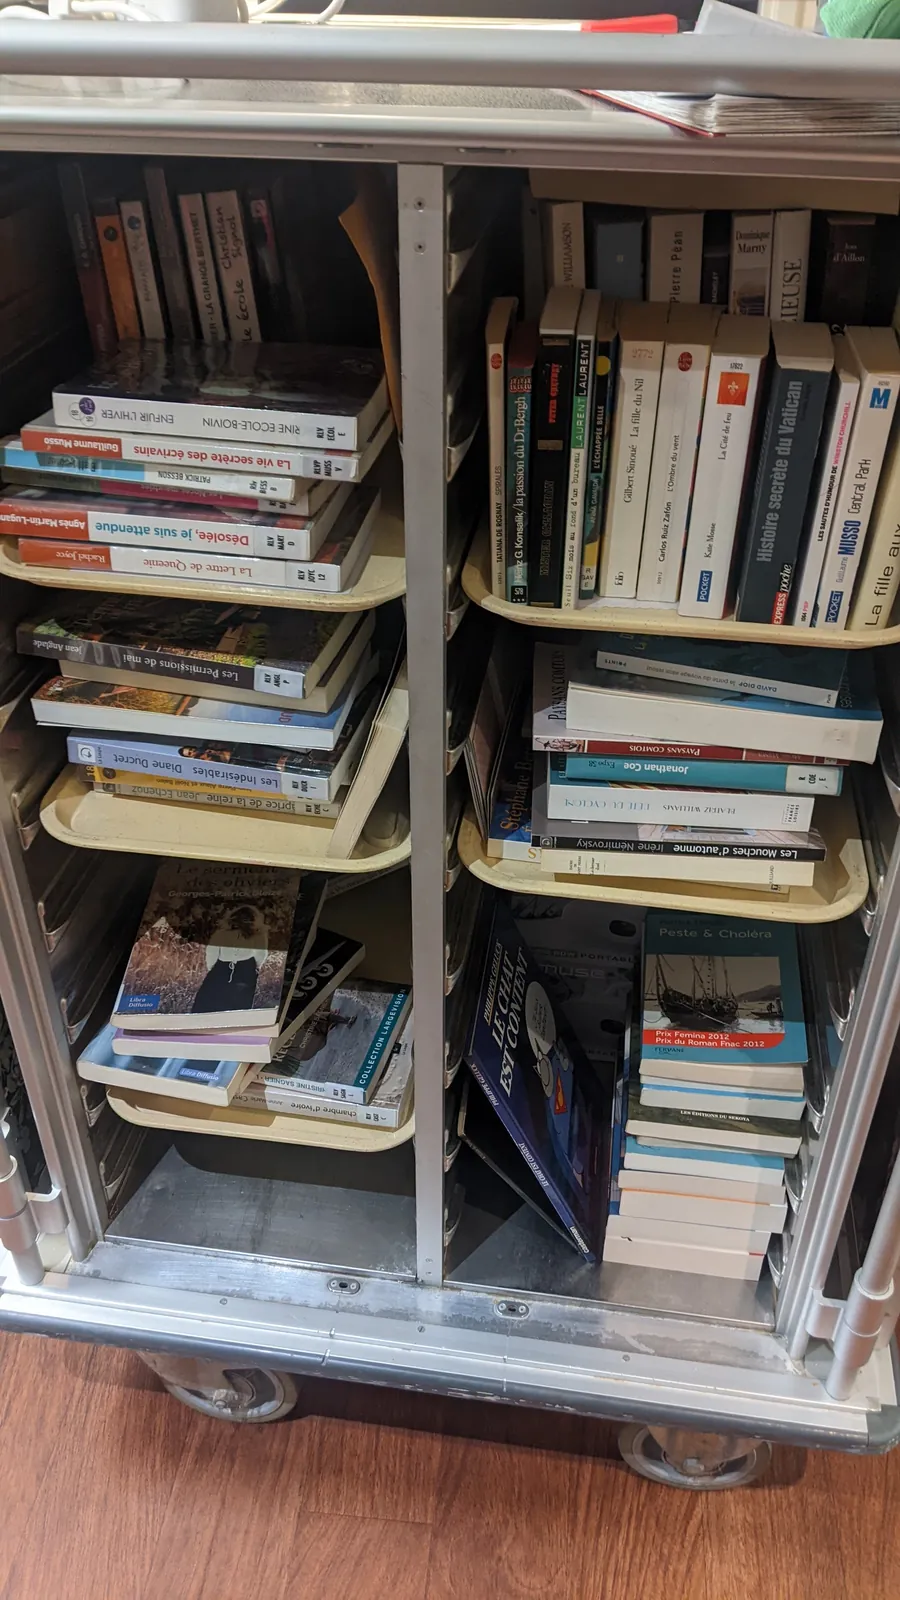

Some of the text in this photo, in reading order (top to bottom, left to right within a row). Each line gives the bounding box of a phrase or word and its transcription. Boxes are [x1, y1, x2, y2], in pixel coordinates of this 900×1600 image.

[216, 205, 233, 270] Christian
[738, 243, 767, 254] Marny
[579, 342, 590, 396] LAURENT
[869, 387, 892, 409] M
[101, 408, 138, 421] L'HIVER
[139, 412, 175, 424] ENFUIR
[514, 395, 528, 428] Bergh
[596, 405, 605, 426] BELLE
[724, 412, 732, 424] feu
[202, 417, 276, 433] ECOLE-BOIVIN
[575, 397, 586, 448] LAURENT
[722, 424, 730, 433] de
[43, 436, 118, 453] Guillaume Musso
[513, 428, 525, 443] Dr
[623, 378, 644, 503] Gilbert Sinoué La fille du Nil
[719, 434, 729, 449] Cité
[134, 445, 291, 470] La vie secrète des écrivains
[513, 443, 525, 458] du
[671, 449, 678, 462] du
[718, 450, 726, 460] La
[158, 470, 211, 484] PATRICK BESSON
[571, 452, 581, 484] bureau
[667, 463, 677, 492] L'Ombre
[756, 381, 803, 562] Histoire secrète du Vatican
[855, 459, 871, 480] Park
[514, 459, 526, 497] passion
[570, 488, 579, 507] d'un
[820, 507, 829, 532] SAUTES
[831, 465, 838, 474] DE
[847, 482, 866, 515] Central
[663, 501, 672, 523] Zafón
[58, 518, 86, 530] Agnès
[95, 521, 249, 546] Désolée, je suis attendue
[496, 527, 503, 538] DE
[661, 523, 669, 539] Ruiz
[838, 520, 862, 556] MUSSO
[56, 551, 105, 563] Rachel Joyce
[659, 540, 667, 562] Carlos
[143, 558, 252, 577] La Lettre de Queenie
[773, 563, 792, 625] EXPRESS poche
[865, 565, 894, 626] La fille
[33, 639, 239, 682] Les Permissions de mai Jean Anglade
[756, 684, 777, 693] DAVID
[629, 744, 700, 756] PAYSANS COMTOIS
[113, 753, 149, 768] Ducret
[152, 760, 182, 774] Diane
[623, 762, 642, 771] Coe
[644, 763, 689, 774] Jonathan
[192, 766, 257, 785] Indésirables
[261, 777, 278, 789] Les
[131, 786, 296, 810] price de la reine Jean Echenoz
[500, 774, 530, 831] Stéphane
[576, 838, 798, 859] Les Mouches d'automne Irène Némirovsky
[659, 927, 772, 939] Peste & Choléra
[492, 951, 517, 1048] LE CHAT
[500, 946, 528, 1097] EST CONTENT
[359, 1037, 385, 1085] COLLECTION
[381, 988, 406, 1035] LARGEVISION
[674, 1031, 706, 1039] Femina
[688, 1039, 718, 1047] Roman
[743, 1040, 765, 1048] 2012
[290, 1102, 321, 1113] d'ivoire
[322, 1106, 357, 1118] chambre
